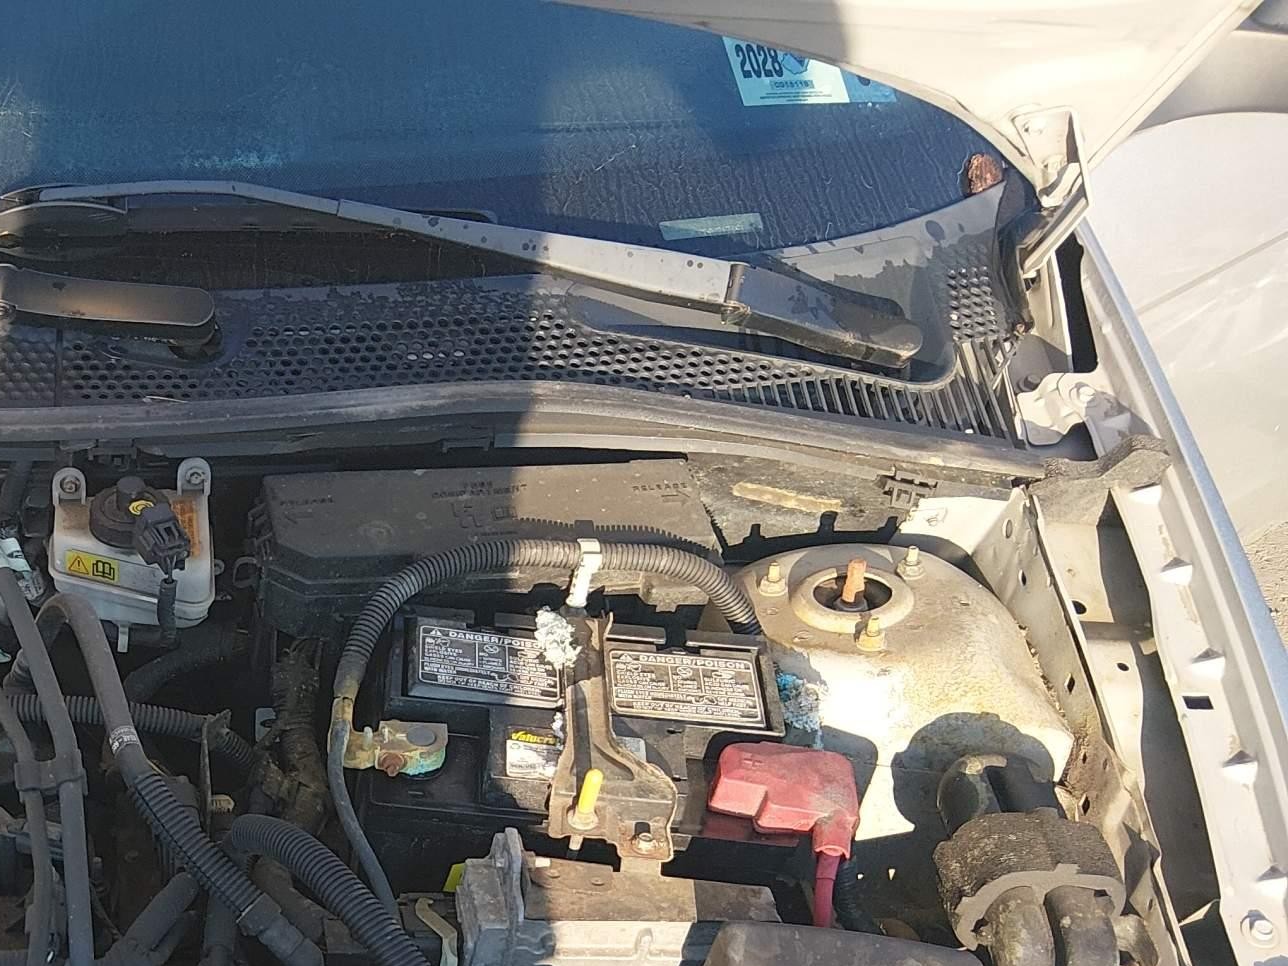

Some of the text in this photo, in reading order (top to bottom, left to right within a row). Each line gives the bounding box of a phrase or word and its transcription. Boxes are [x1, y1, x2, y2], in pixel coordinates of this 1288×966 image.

[735, 44, 783, 78] 2028
[449, 631, 543, 650] DANGER/POISO
[639, 653, 745, 672] DANGER/POISON
